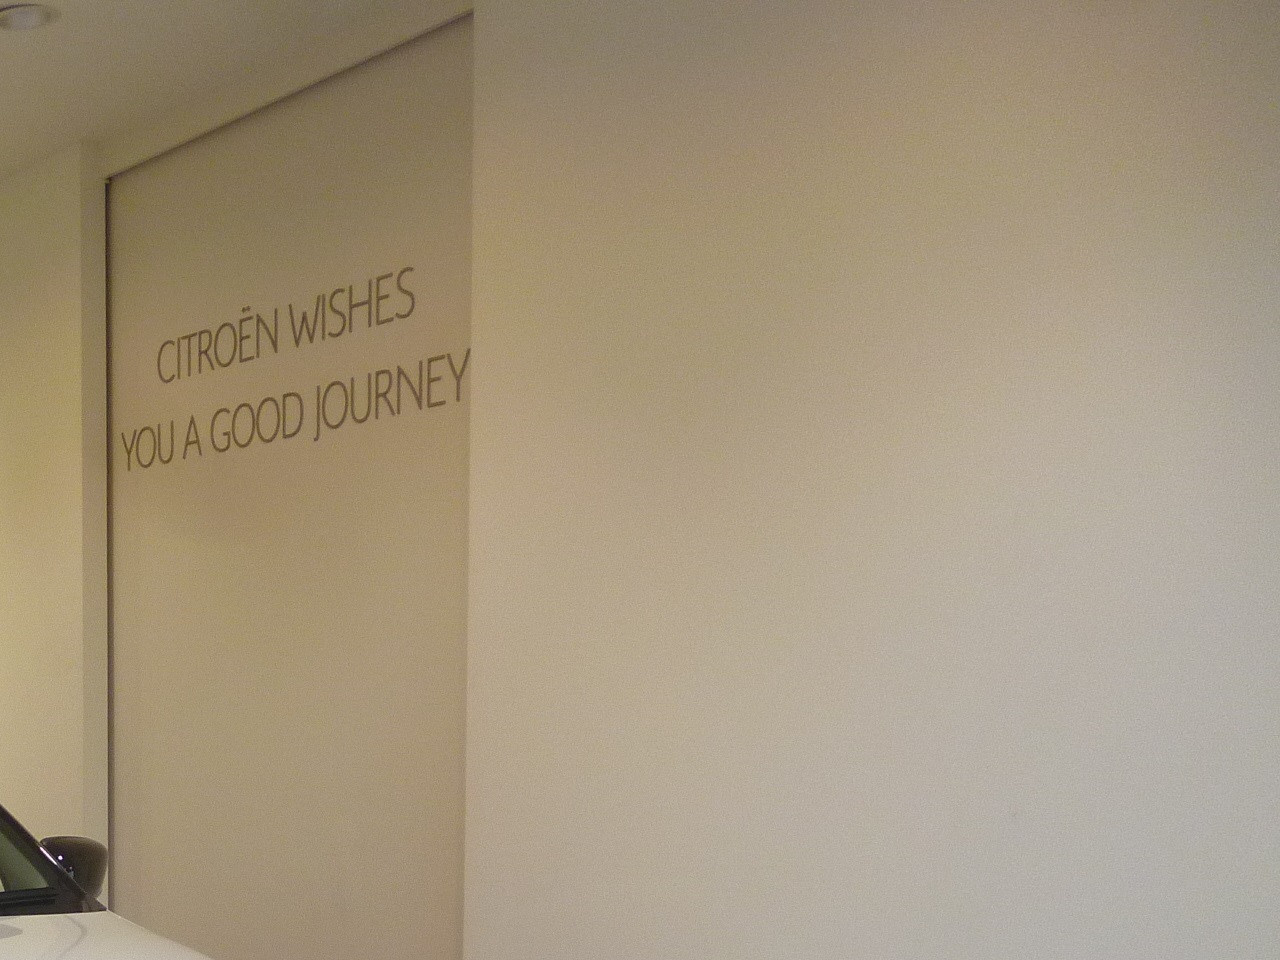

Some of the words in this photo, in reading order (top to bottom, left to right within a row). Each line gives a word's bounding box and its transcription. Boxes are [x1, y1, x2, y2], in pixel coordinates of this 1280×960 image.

[157, 306, 279, 384] CITROËN
[288, 266, 415, 348] WISHES
[121, 420, 175, 472] YOU
[182, 414, 203, 460] A
[209, 392, 304, 453] GOOD
[313, 348, 472, 442] JOURNEY
